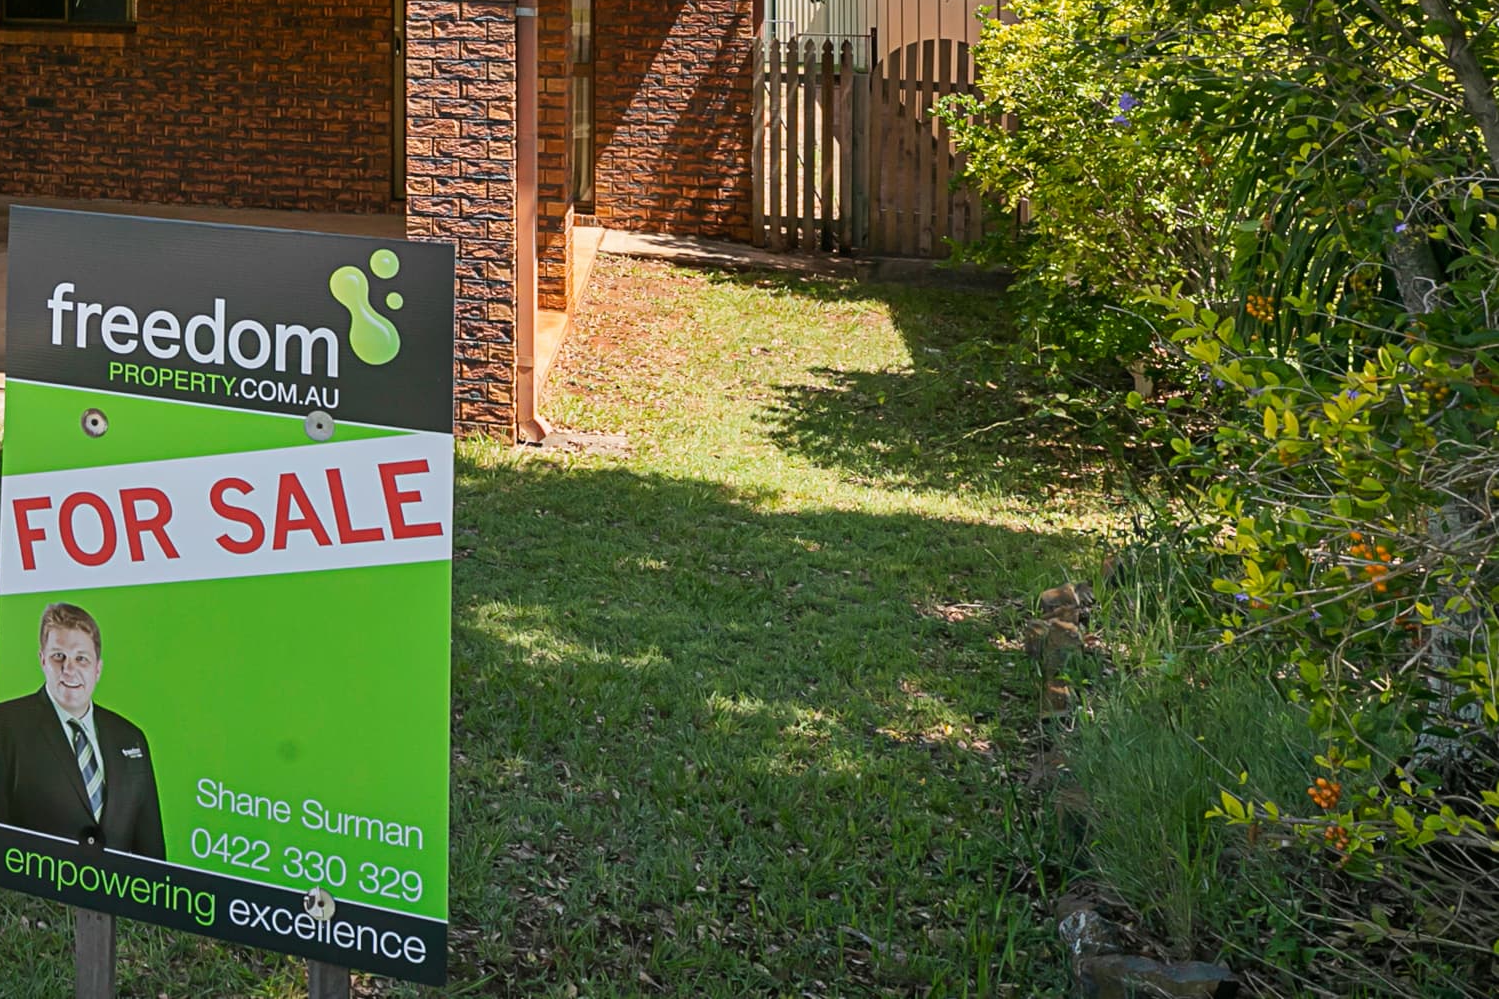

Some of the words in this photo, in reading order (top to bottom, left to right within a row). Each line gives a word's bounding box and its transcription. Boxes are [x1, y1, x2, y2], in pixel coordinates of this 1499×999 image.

[47, 282, 339, 378] freedom
[108, 361, 340, 409] PROPERTY.COM.AU
[12, 486, 180, 571] FOR
[209, 458, 444, 555] SALE
[196, 778, 292, 823] Shane
[301, 799, 423, 850] Surman
[4, 847, 217, 926] empowering
[190, 828, 271, 872] 0422
[283, 846, 347, 887] 330
[358, 862, 423, 903] 329
